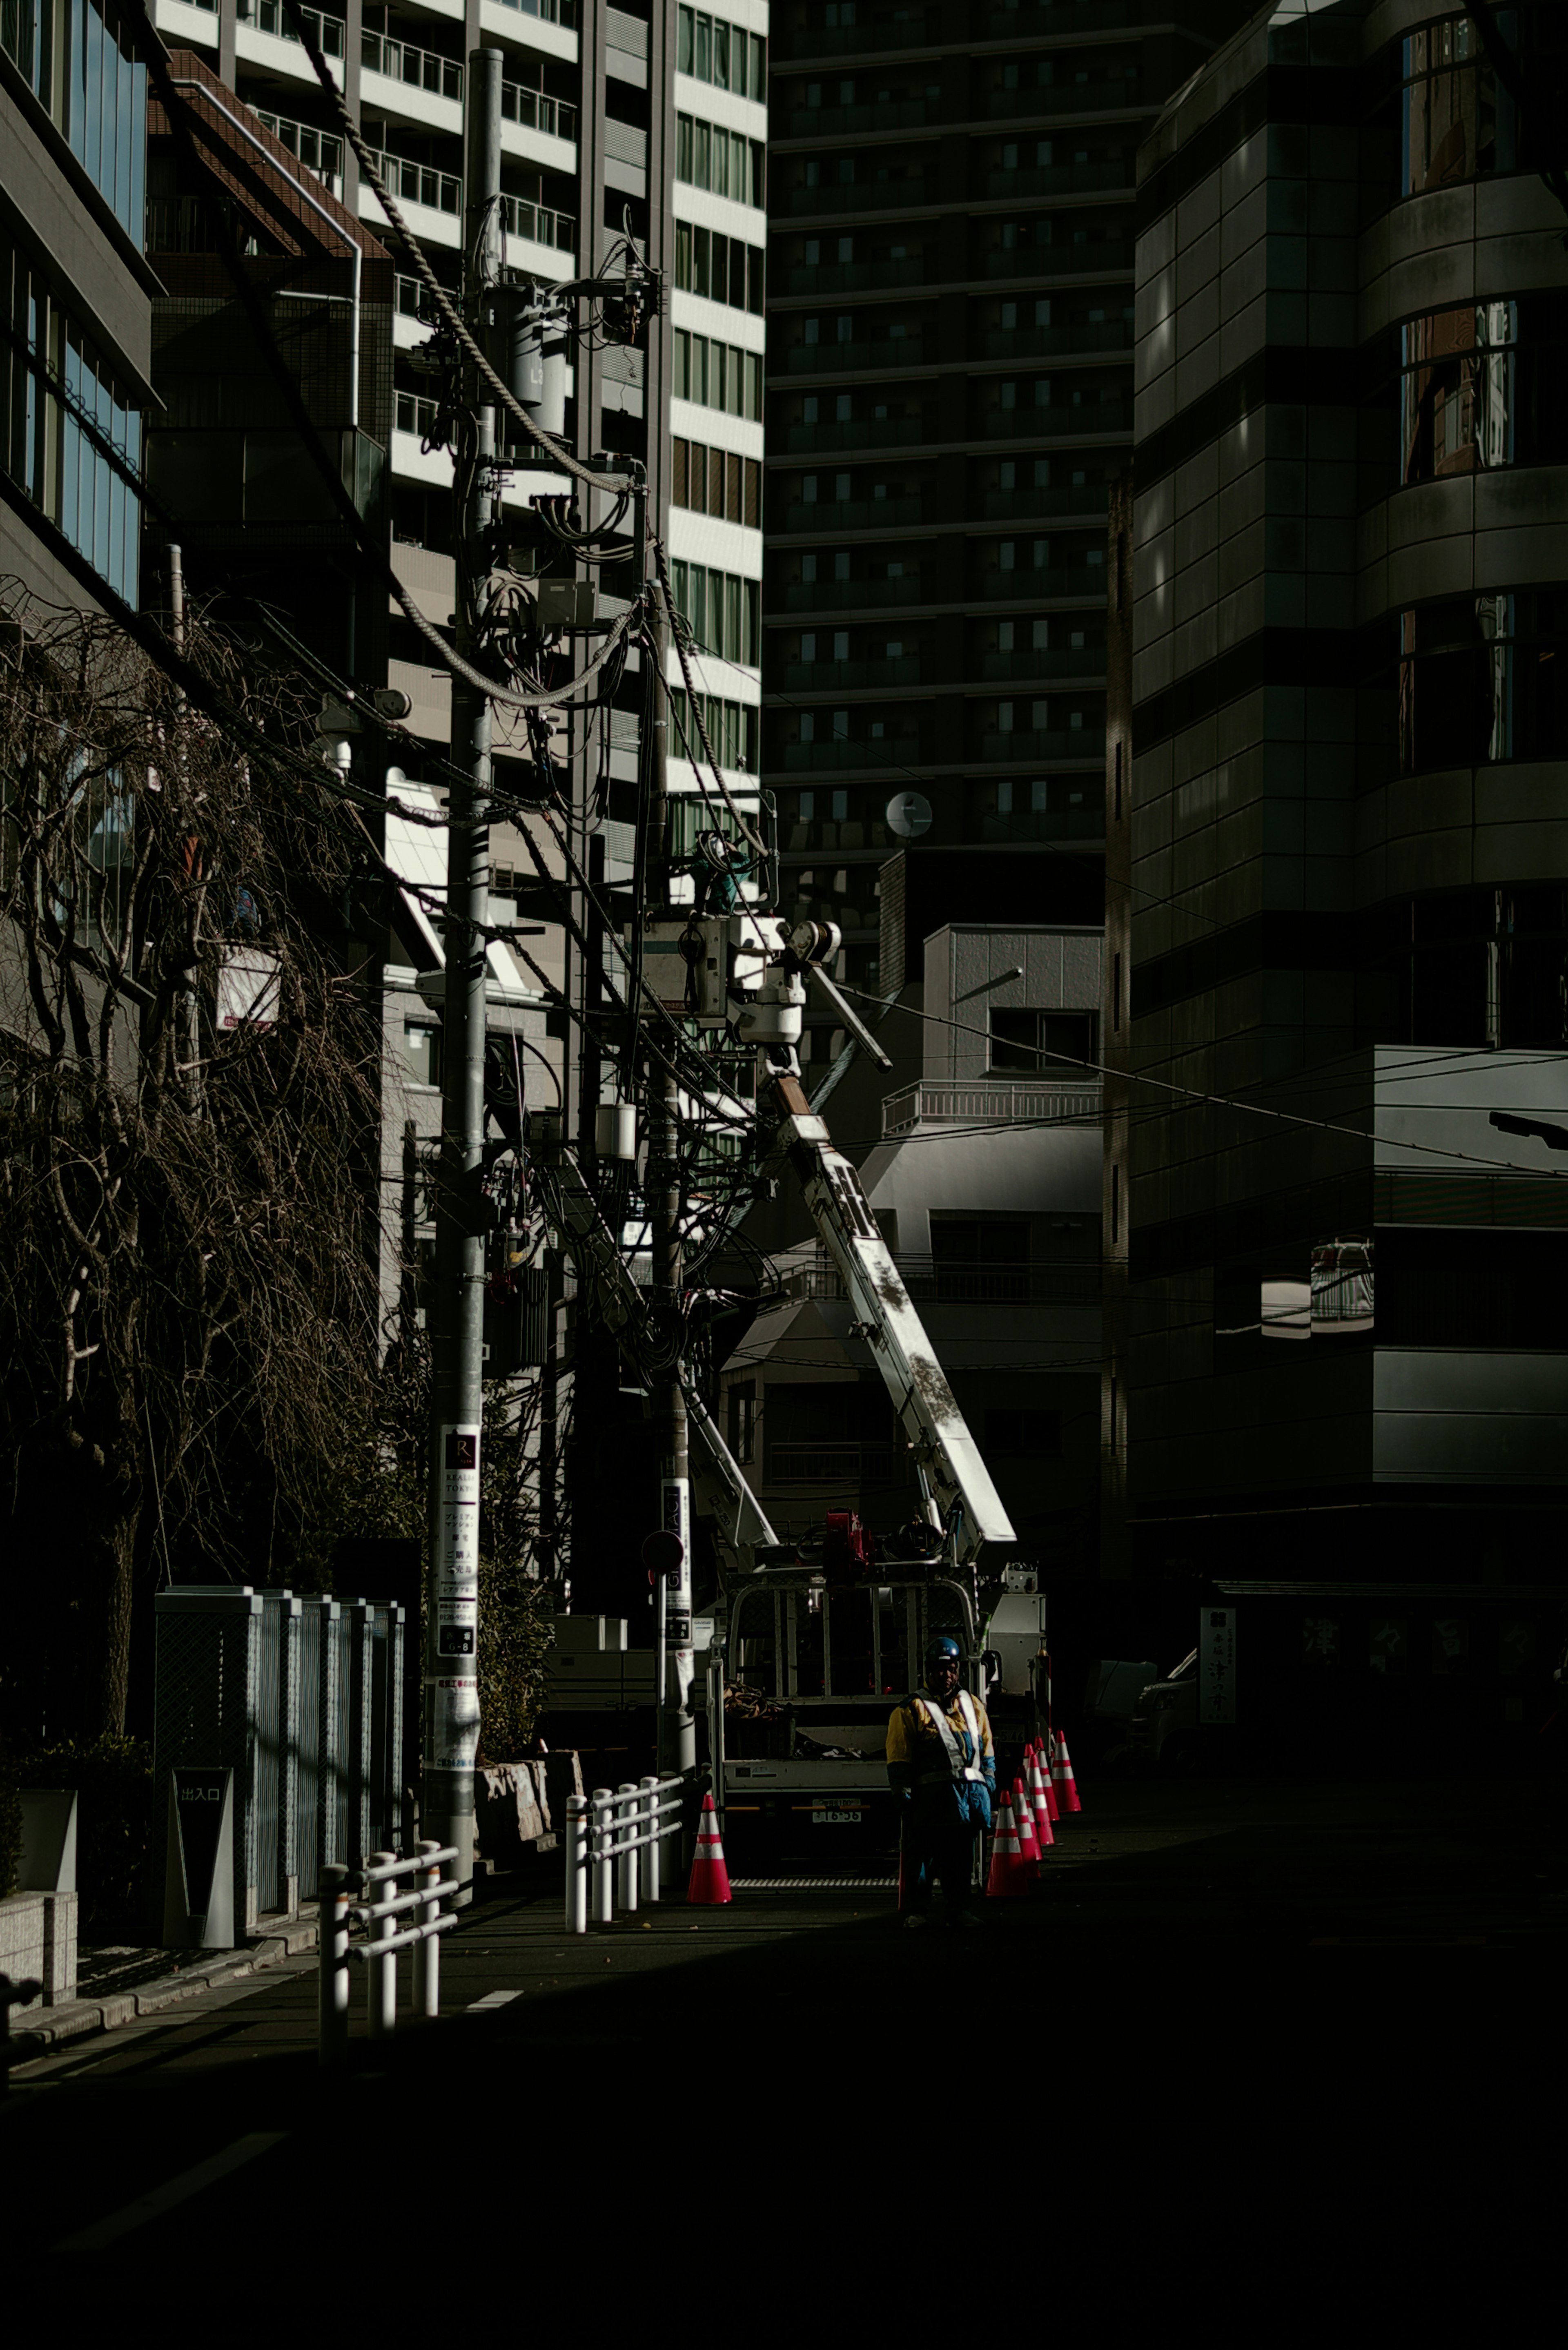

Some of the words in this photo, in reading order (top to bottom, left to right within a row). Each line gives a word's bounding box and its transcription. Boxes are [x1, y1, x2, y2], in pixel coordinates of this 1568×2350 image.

[457, 1440, 472, 1457] R
[447, 1551, 472, 1559] ご購入
[1302, 1617, 1339, 1654] 津
[181, 1787, 220, 1801] 出入口
